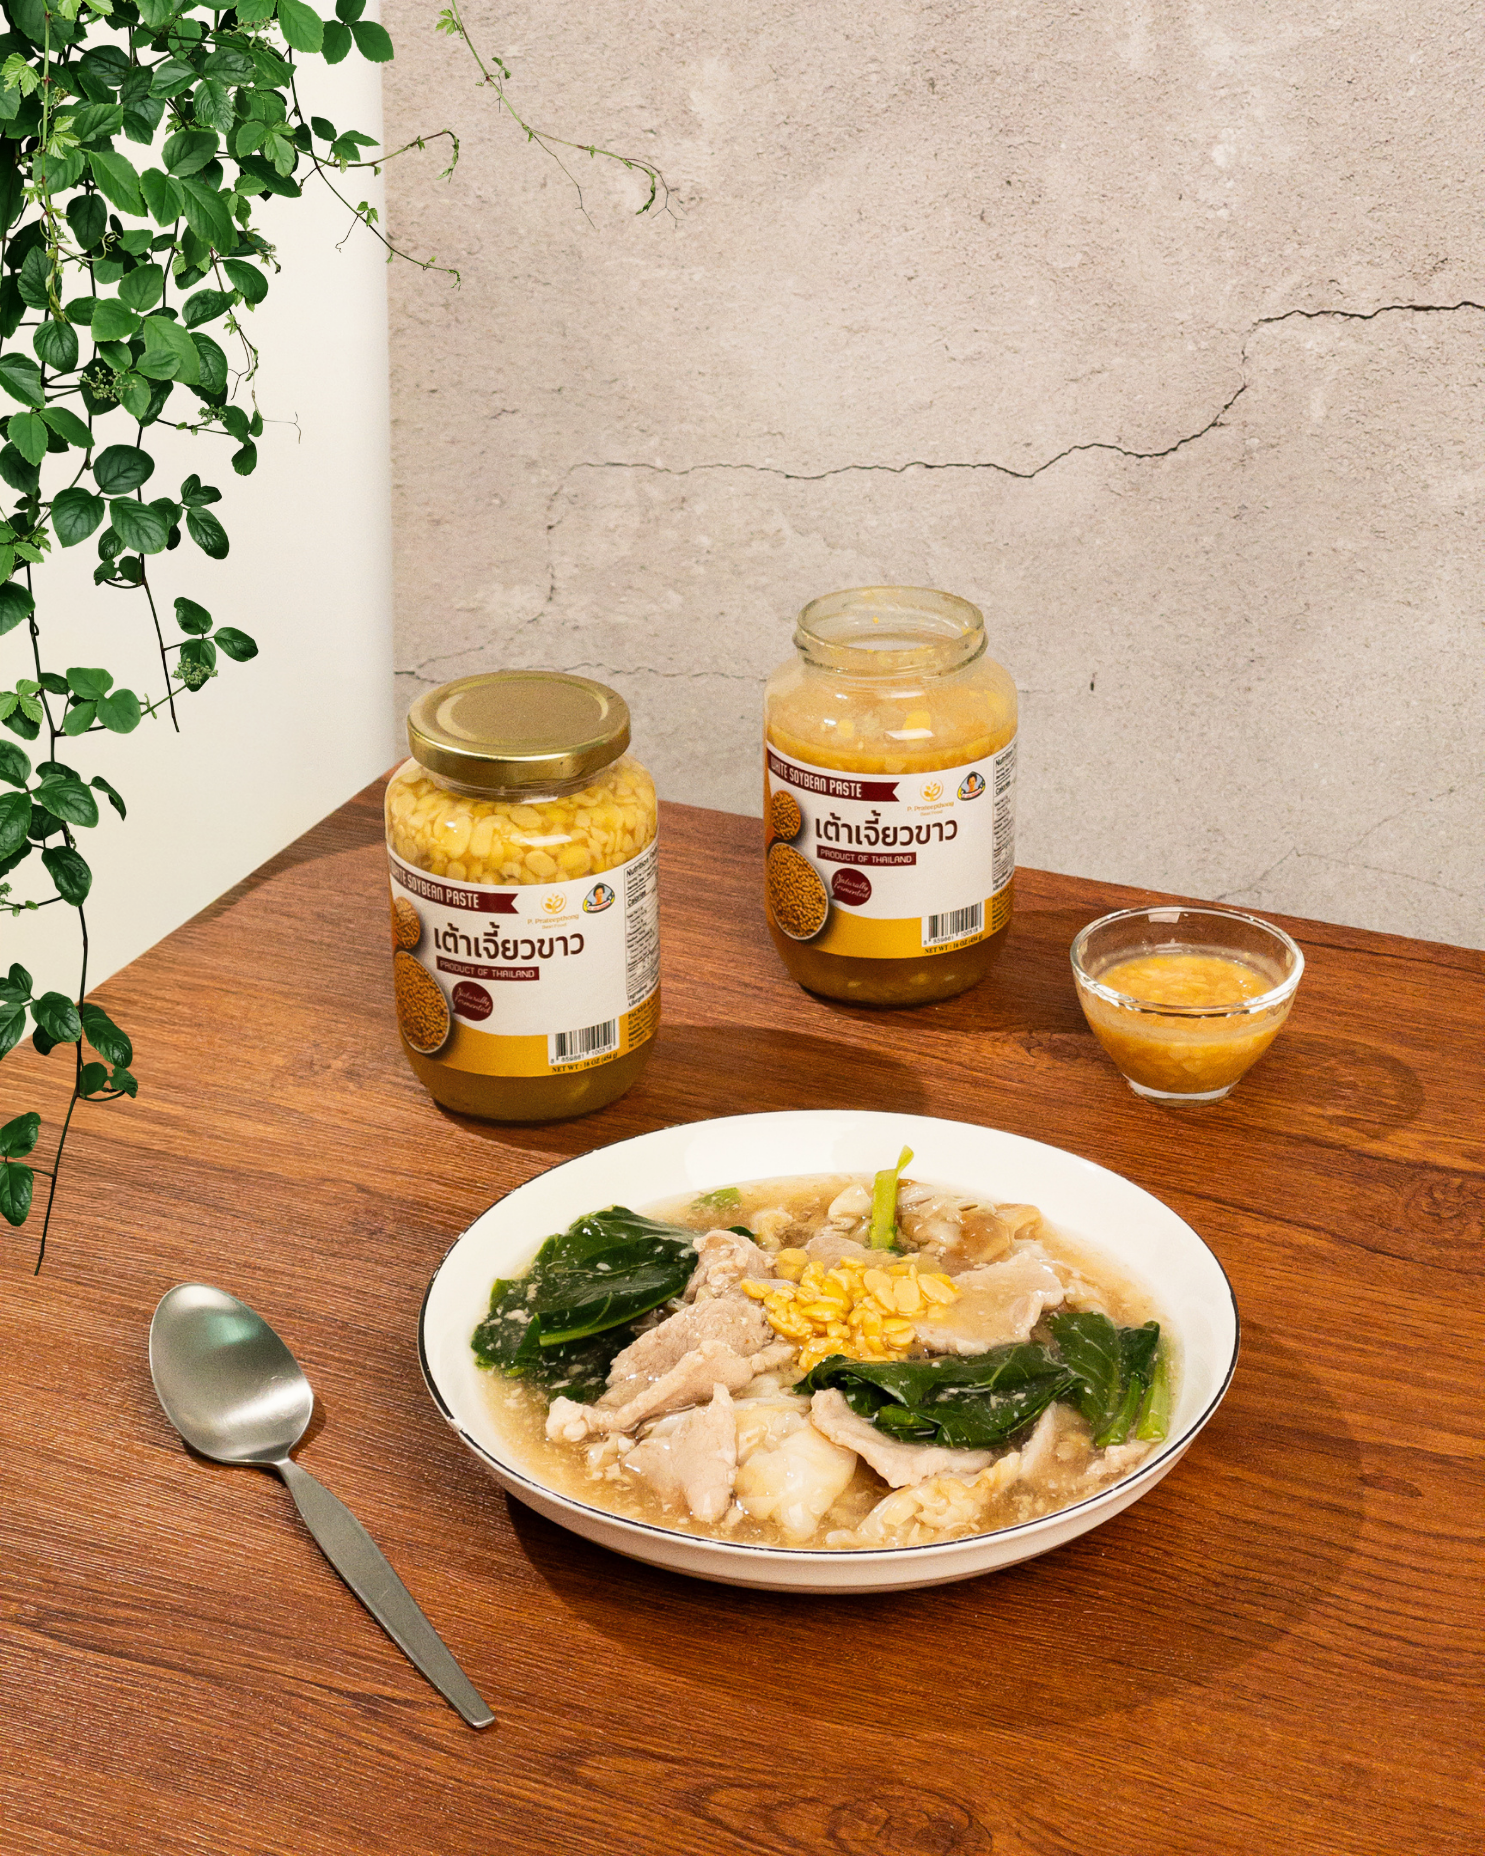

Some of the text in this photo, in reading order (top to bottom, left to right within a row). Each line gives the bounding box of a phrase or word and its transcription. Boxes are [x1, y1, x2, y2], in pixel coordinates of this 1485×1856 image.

[789, 767, 827, 793] SOYBEAN
[829, 779, 862, 798] PASTE
[815, 809, 958, 847] เต้าเจี้ยวขาว
[820, 848, 913, 864] PRODUCT OF THAILAND
[407, 874, 444, 902] SOYBEAN
[446, 888, 479, 909] PASTE
[434, 921, 585, 961] เต้าเจี้ยวขาว
[440, 961, 535, 979] PRODUCT OF THAILAND
